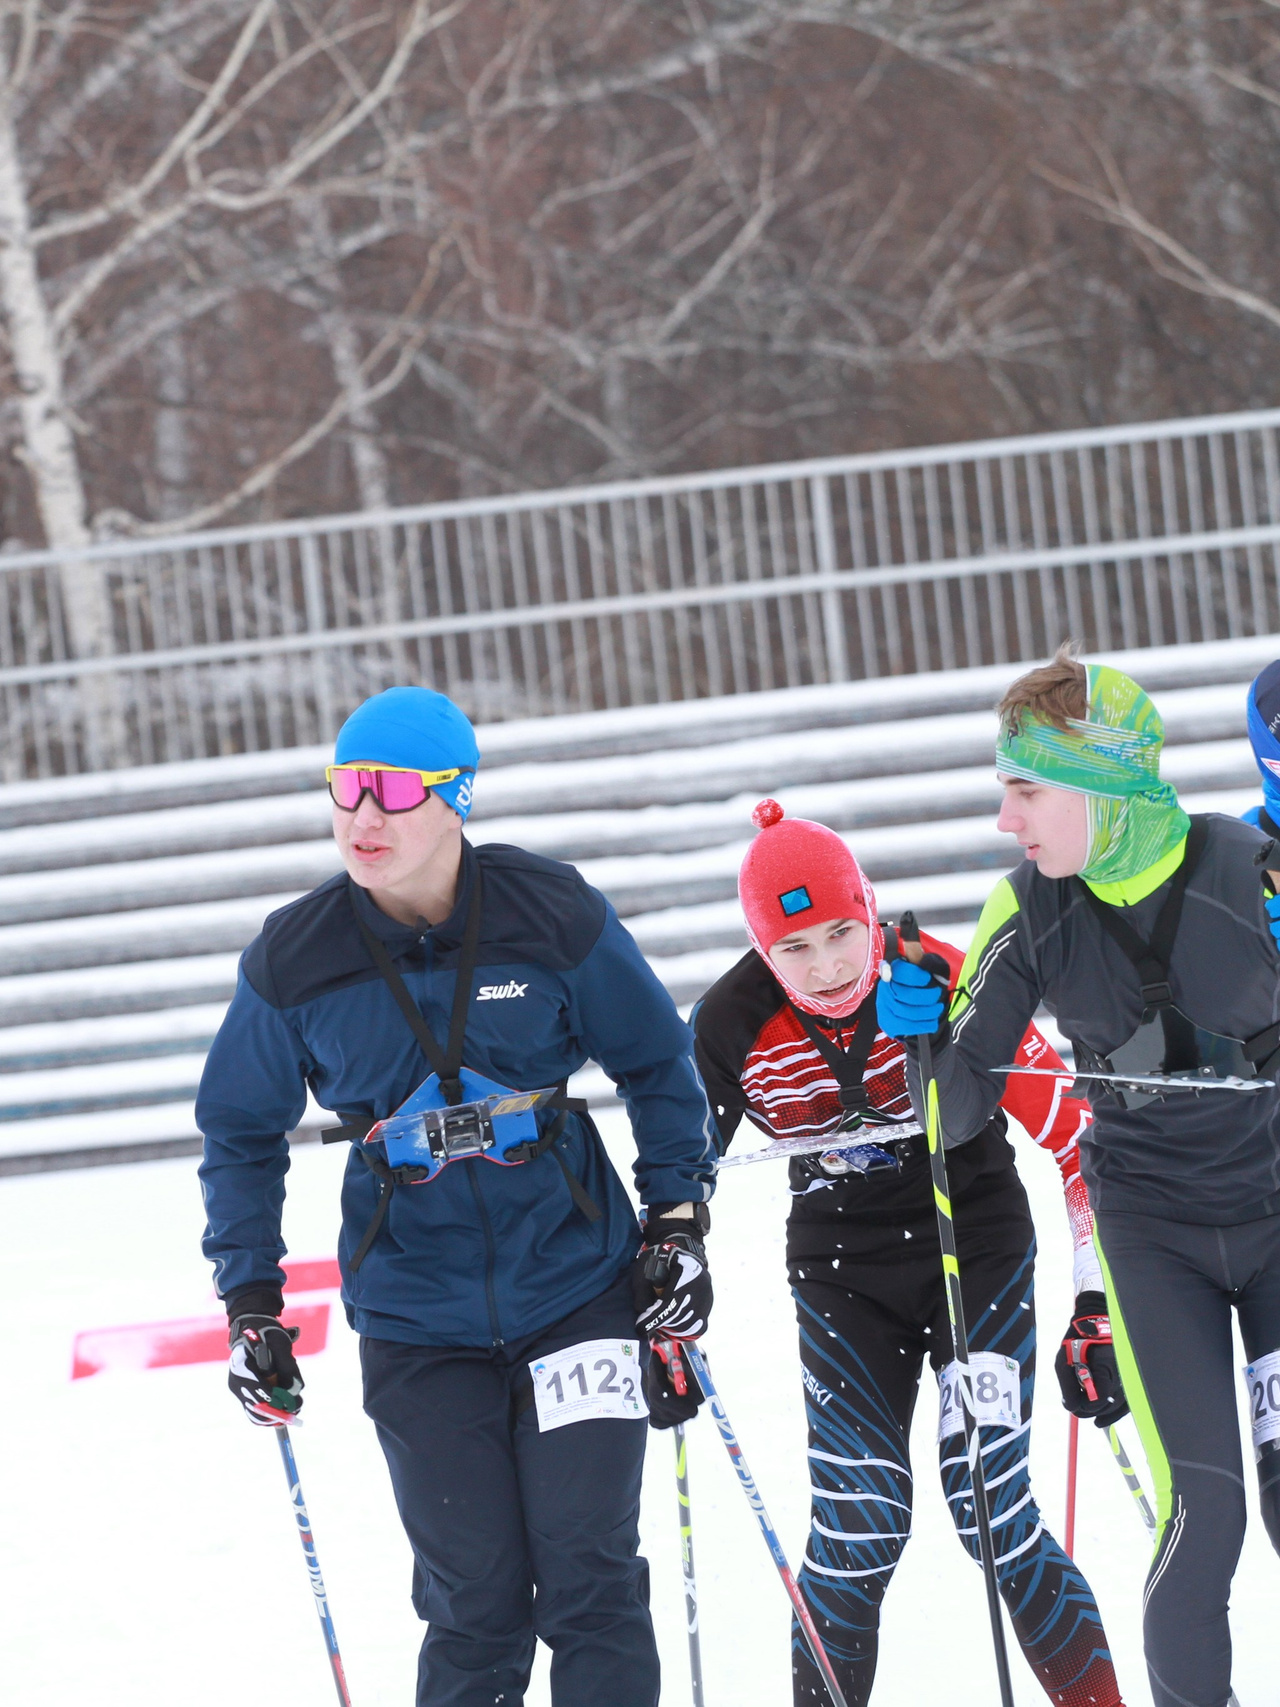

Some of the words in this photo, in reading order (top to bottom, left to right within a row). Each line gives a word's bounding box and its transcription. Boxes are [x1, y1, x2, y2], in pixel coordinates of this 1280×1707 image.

[644, 1318, 659, 1332] SKI
[657, 1298, 678, 1321] TIME
[546, 1358, 621, 1404] 112
